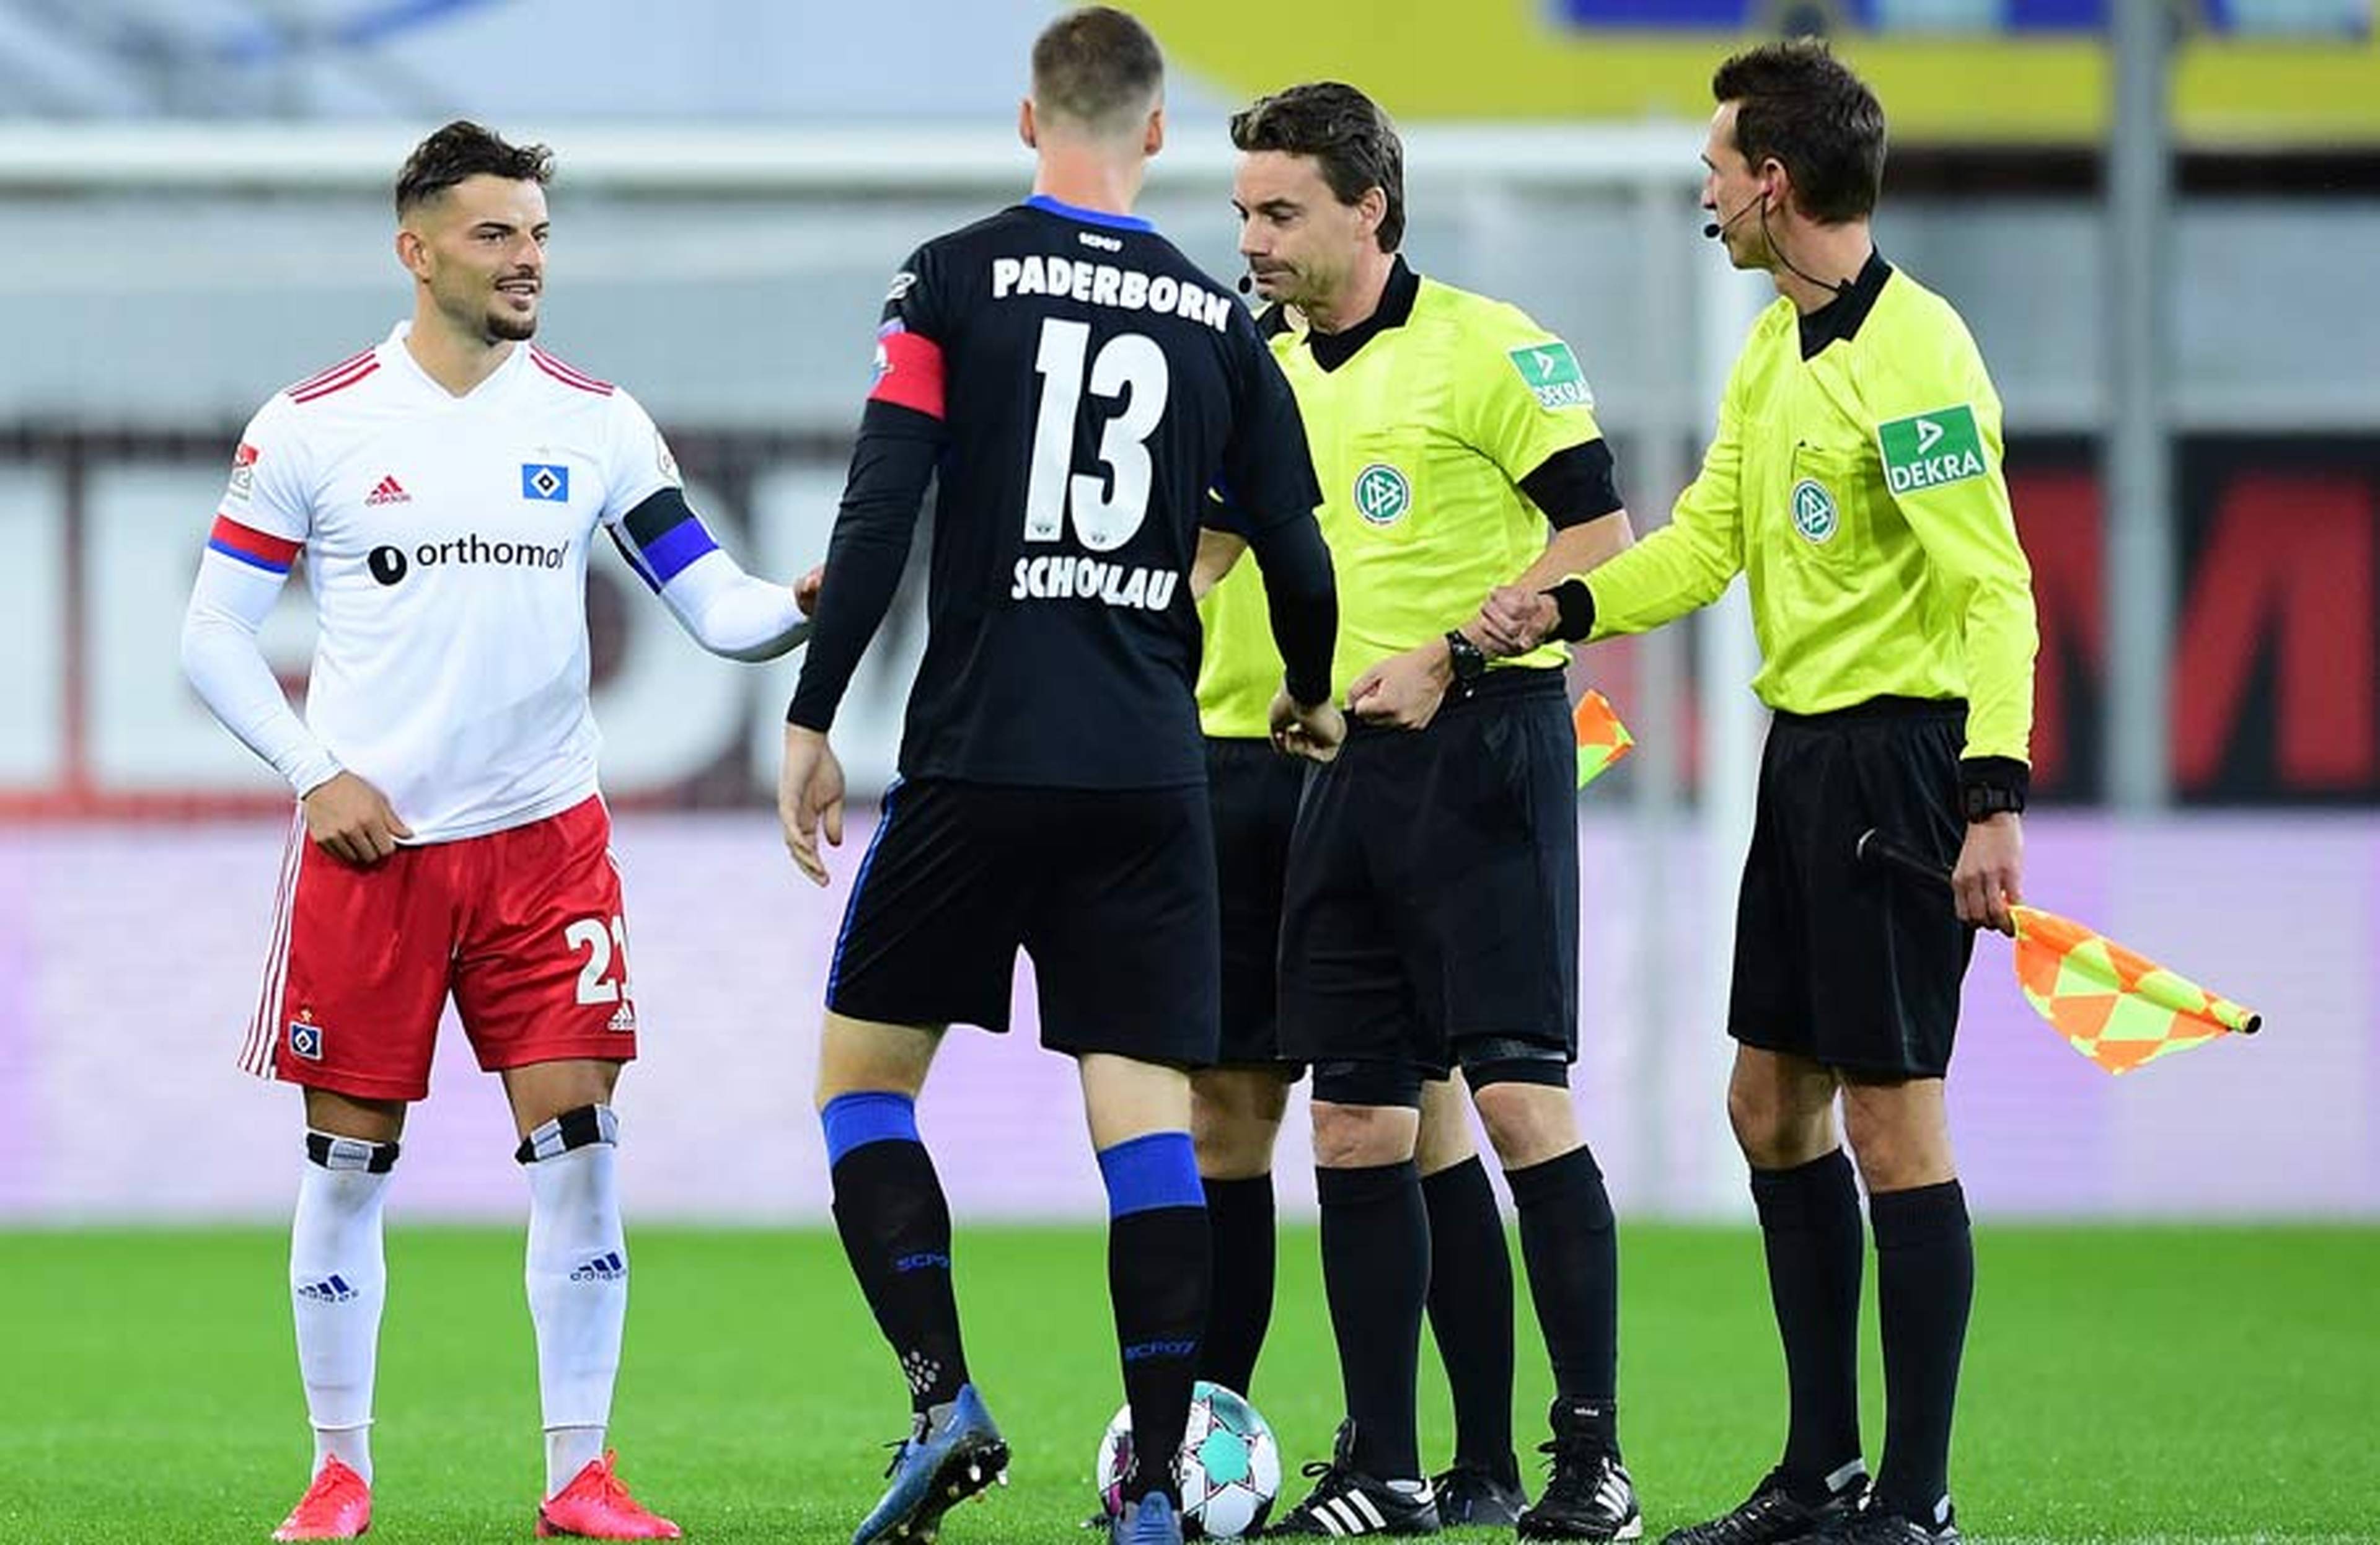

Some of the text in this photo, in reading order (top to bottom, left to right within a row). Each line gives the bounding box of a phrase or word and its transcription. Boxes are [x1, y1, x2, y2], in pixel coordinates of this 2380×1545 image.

[992, 255, 1232, 333] PADERBORN
[1023, 317, 1169, 552] 13
[1890, 449, 1983, 491] DEKRA
[416, 533, 568, 569] orthomol
